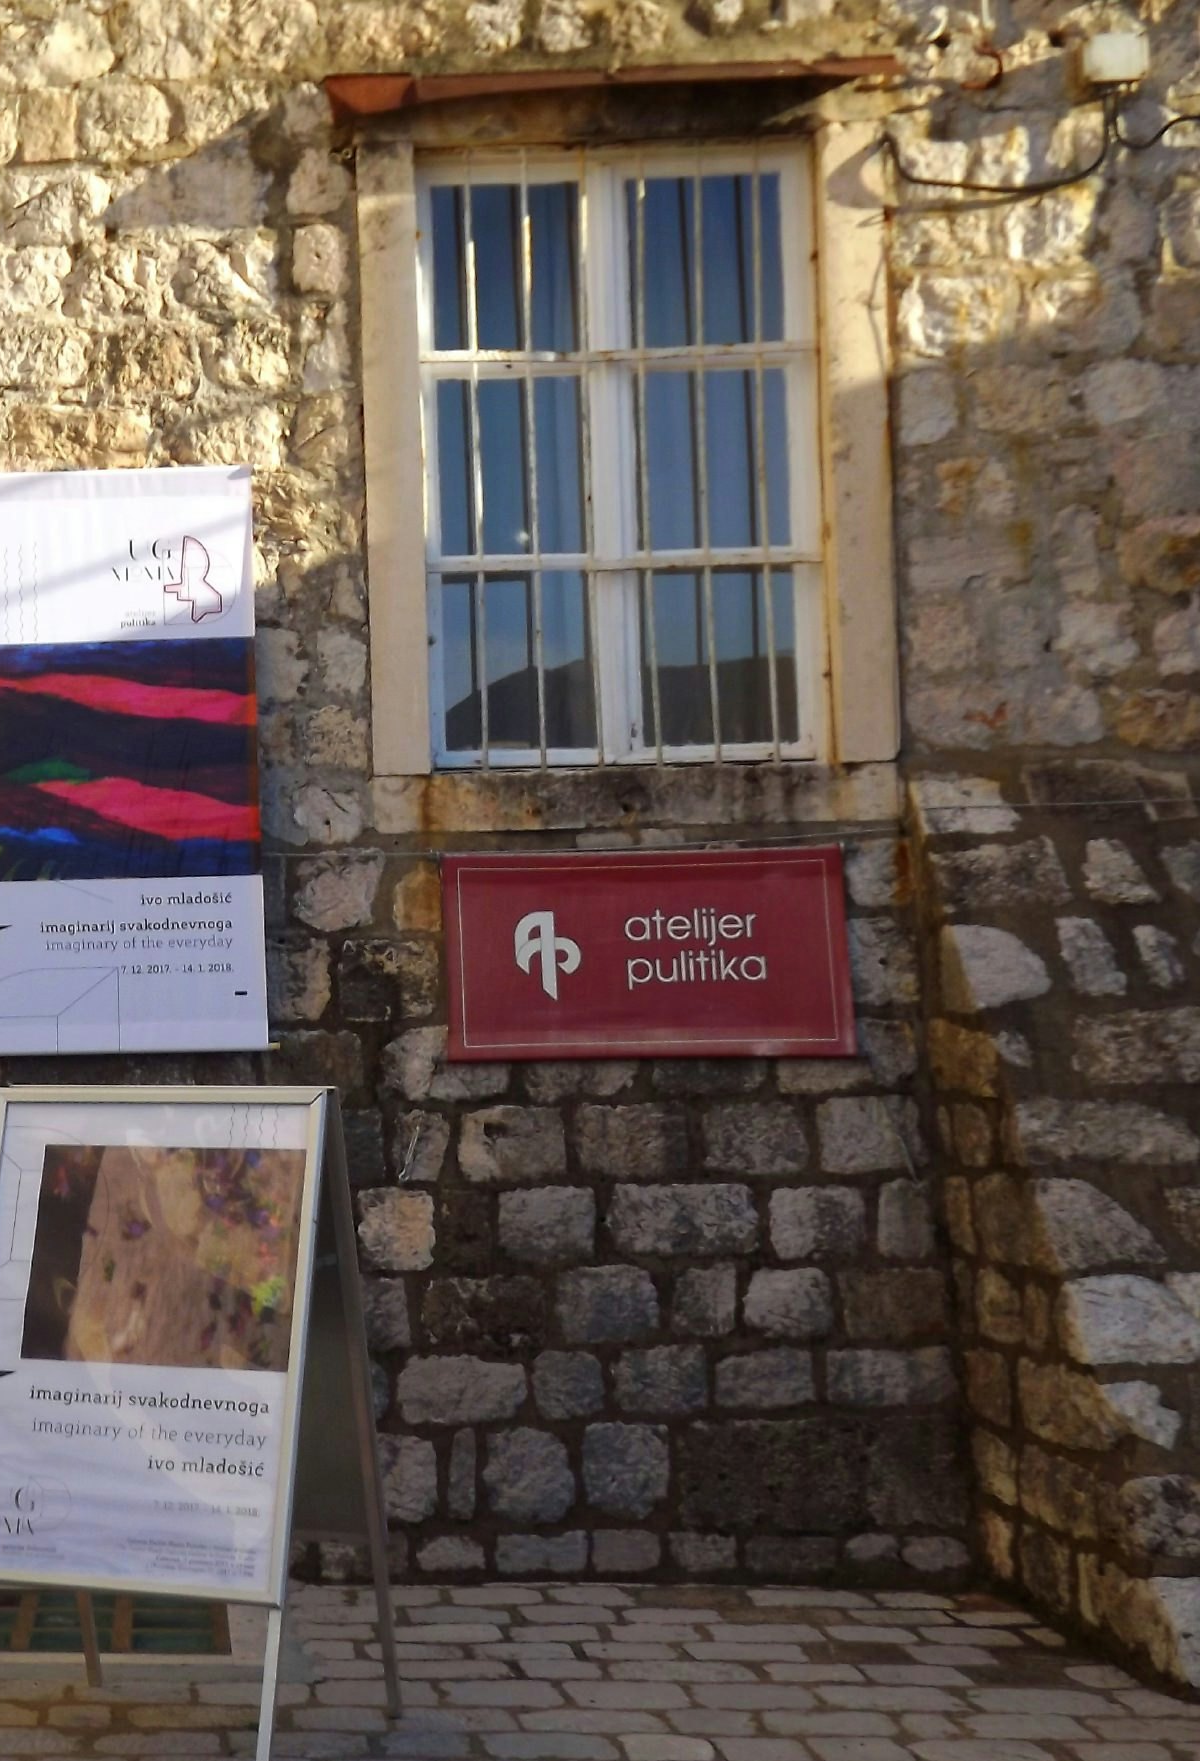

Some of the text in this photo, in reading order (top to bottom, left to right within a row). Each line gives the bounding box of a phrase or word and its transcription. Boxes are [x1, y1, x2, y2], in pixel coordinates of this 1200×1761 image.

[140, 891, 233, 905] ivo mladošić
[40, 917, 233, 935] imaginarij svakodnevnoga
[624, 907, 758, 946] atelijer
[45, 936, 233, 953] imaginary of the everyday
[626, 949, 768, 990] pulitika
[29, 1385, 270, 1417] imaginarij svakodnevnoga
[32, 1417, 268, 1448] imaginary of the everyday
[147, 1455, 265, 1477] ivo mladošić
